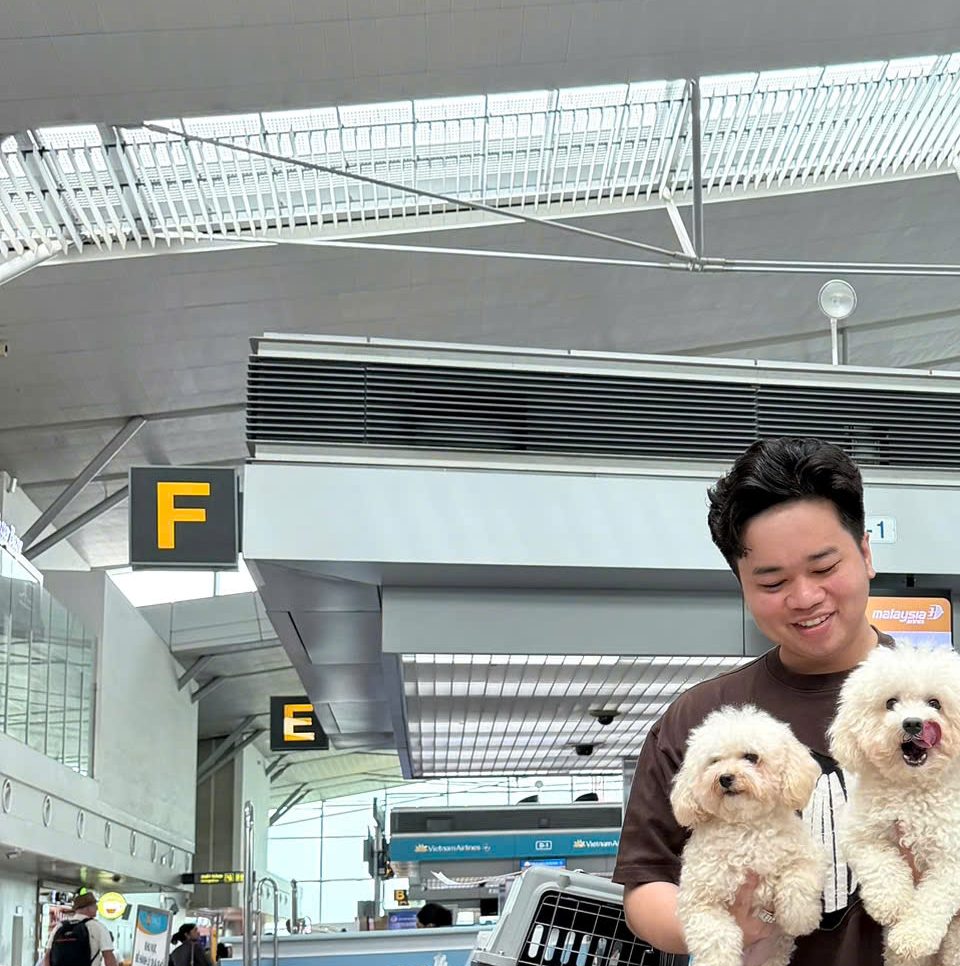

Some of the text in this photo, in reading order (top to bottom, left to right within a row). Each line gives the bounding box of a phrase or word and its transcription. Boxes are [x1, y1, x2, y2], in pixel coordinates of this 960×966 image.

[156, 481, 211, 549] F
[866, 520, 885, 539] -1
[872, 608, 927, 623] malaysia
[283, 703, 315, 742] E
